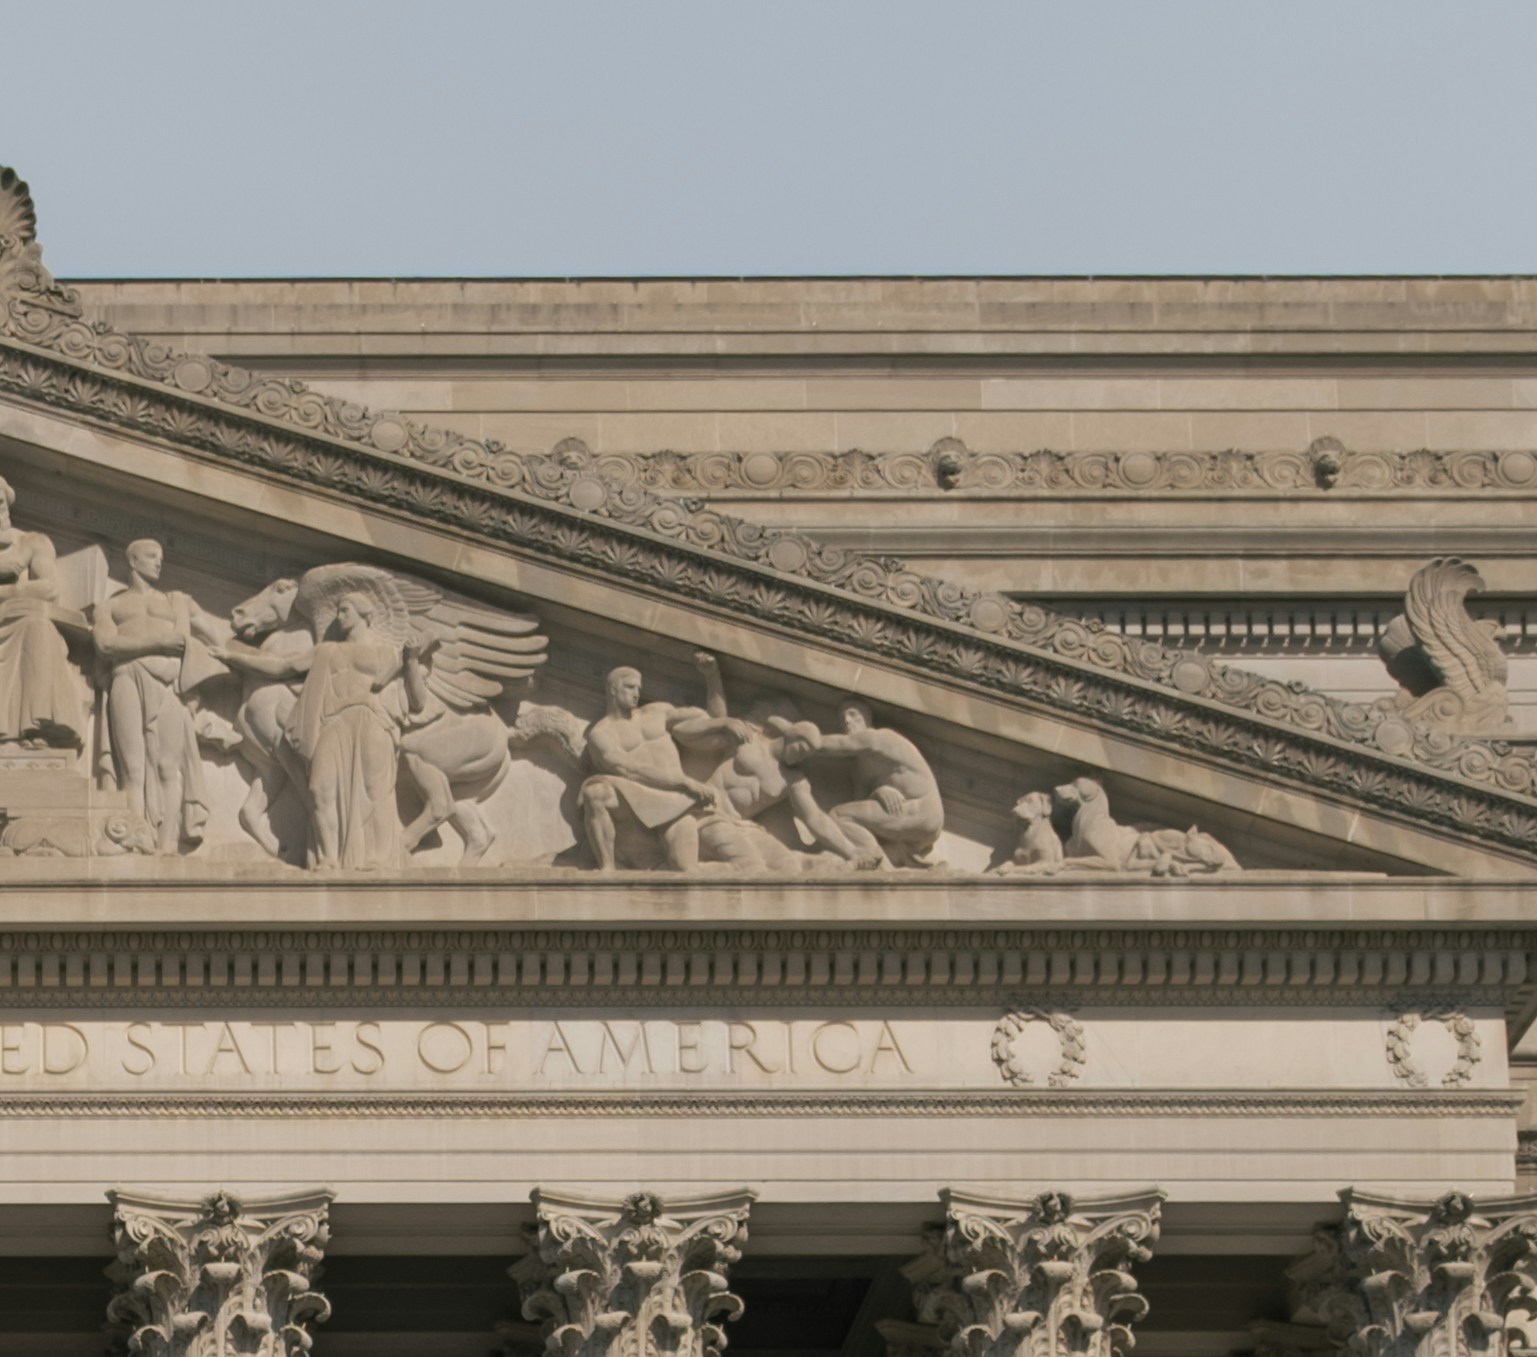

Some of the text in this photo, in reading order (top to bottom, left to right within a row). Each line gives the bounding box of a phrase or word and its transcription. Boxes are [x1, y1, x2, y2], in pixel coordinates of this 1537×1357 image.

[121, 1021, 386, 1077] STATES
[414, 1021, 508, 1077] OF
[535, 1021, 916, 1077] AMERICA
